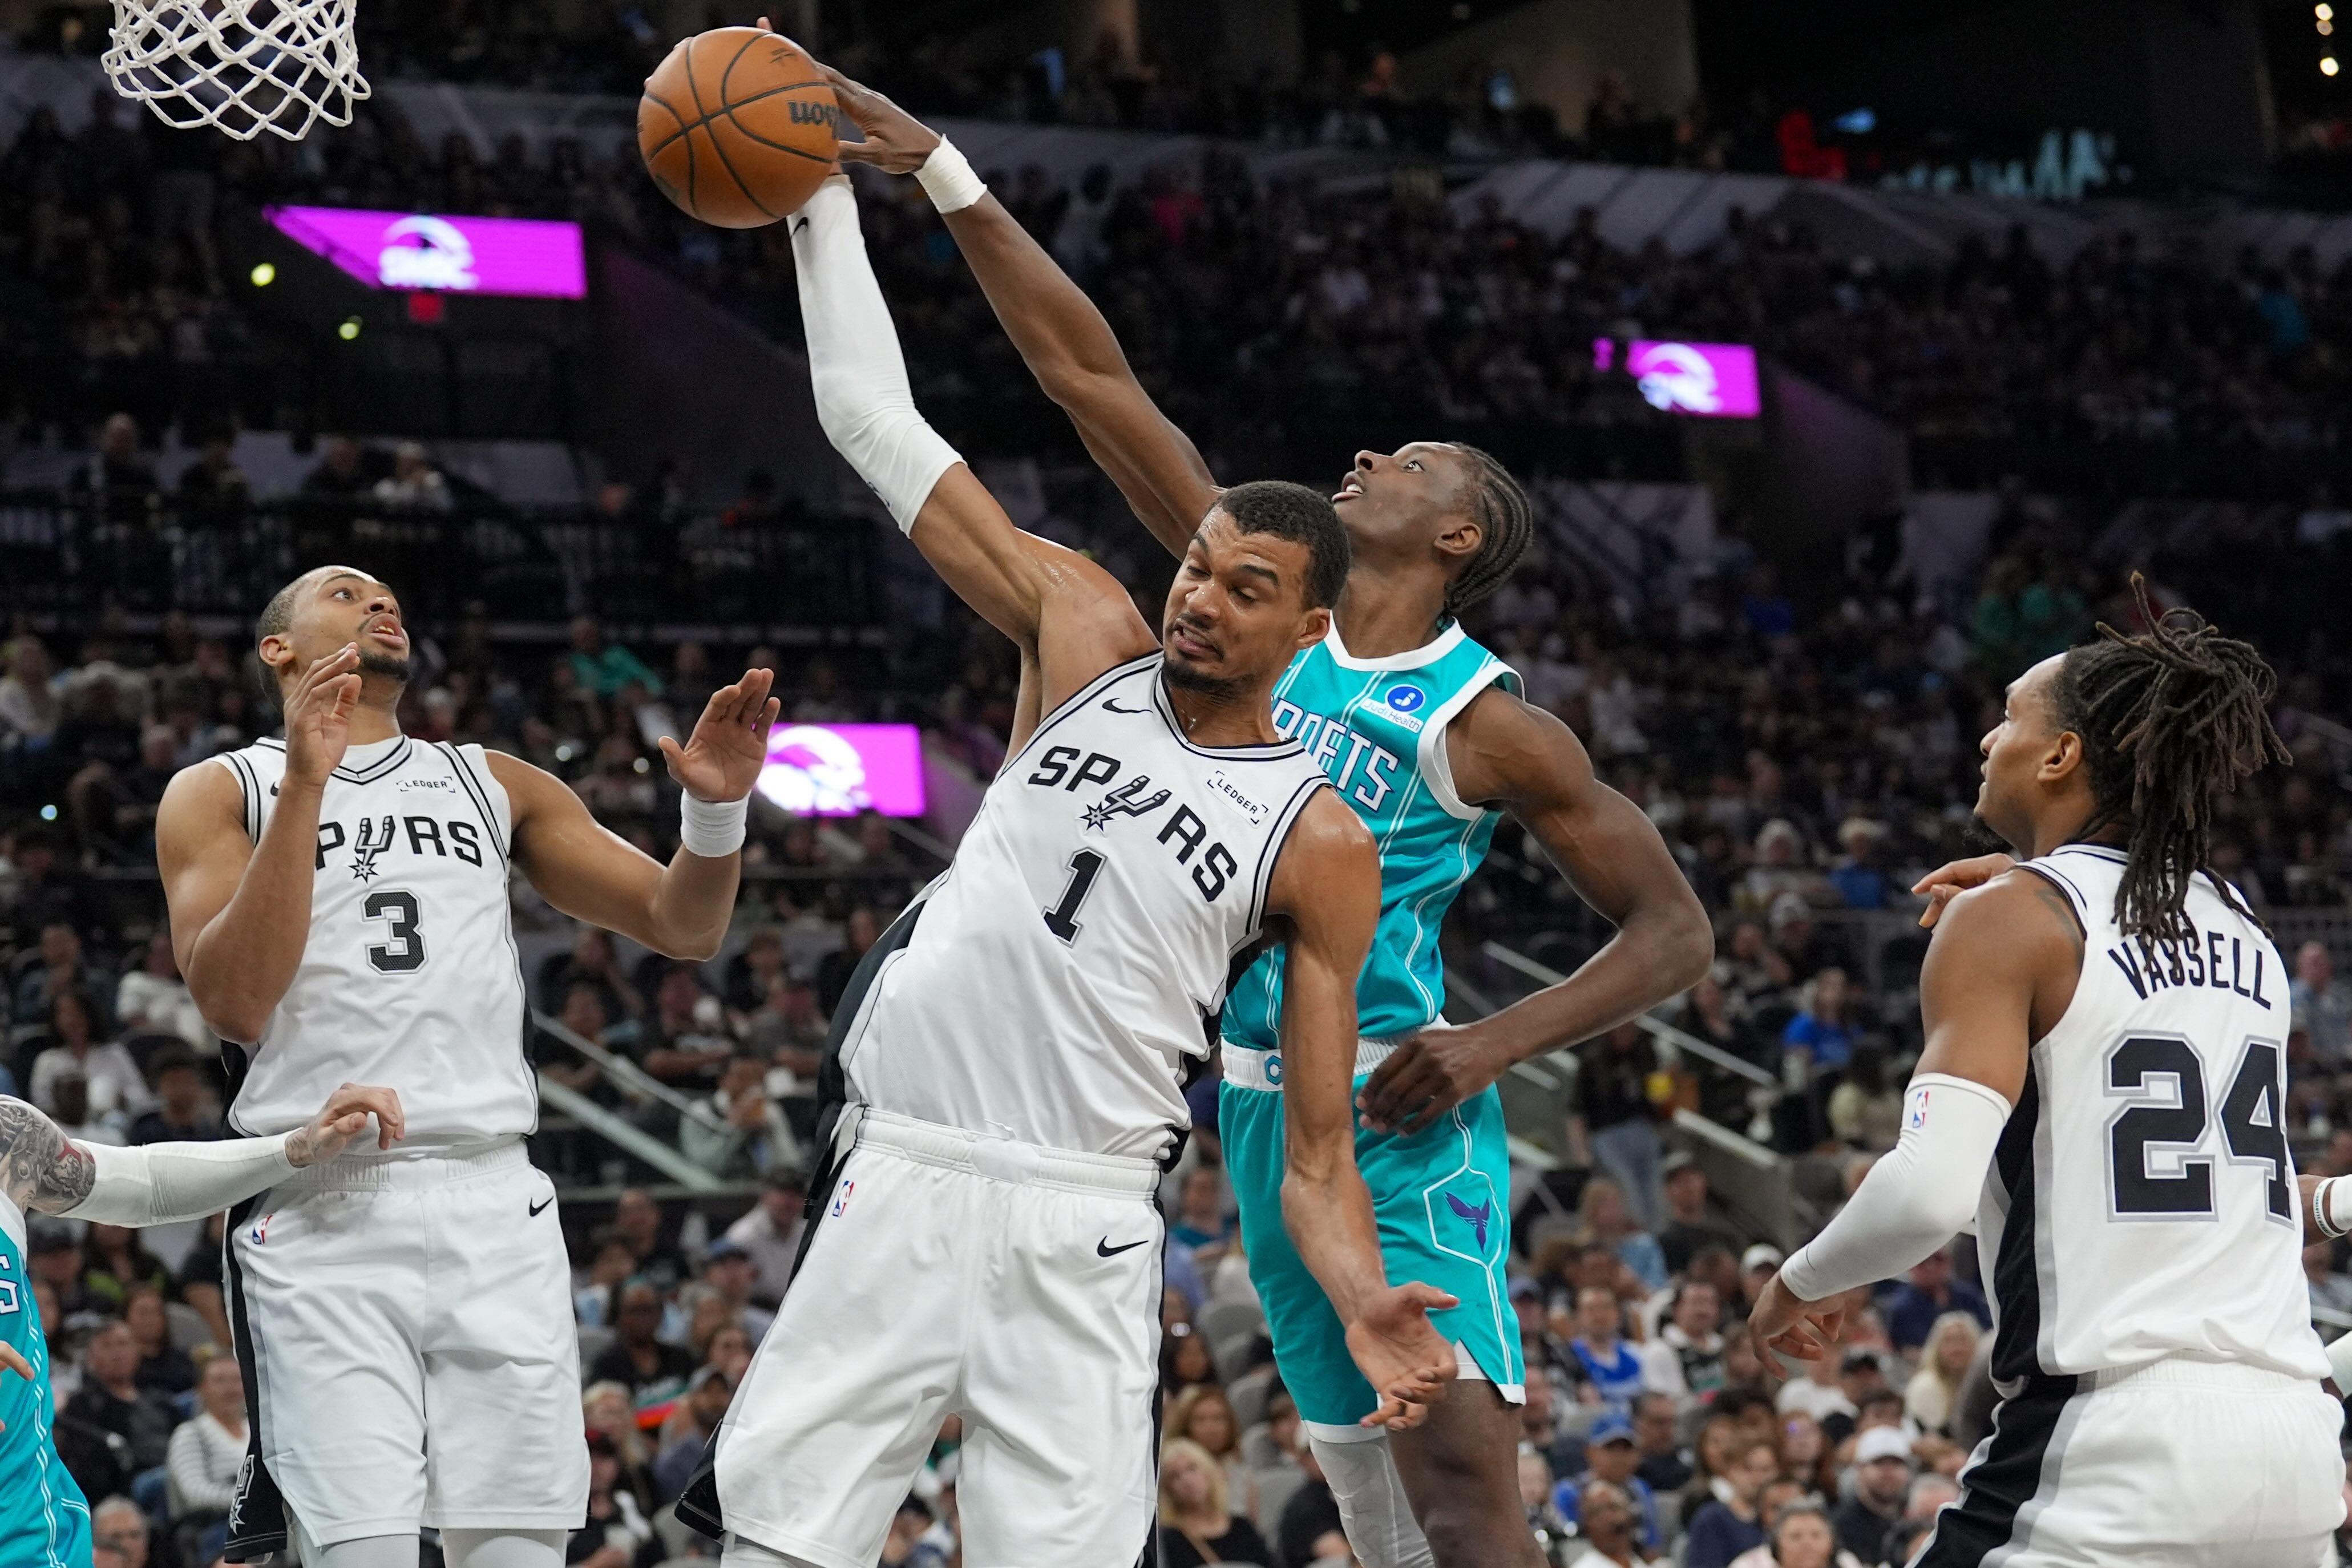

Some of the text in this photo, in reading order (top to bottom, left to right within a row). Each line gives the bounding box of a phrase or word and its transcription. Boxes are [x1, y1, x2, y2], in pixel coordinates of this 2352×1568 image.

[1387, 711, 1420, 732] Health
[405, 779, 447, 788] LEDGER
[1217, 778, 1258, 814] LEDGER
[316, 815, 482, 883] PURS
[1028, 746, 1238, 902] SPURS
[359, 888, 429, 976] 3
[1042, 846, 1108, 949] 1
[2102, 1029, 2295, 1230] 24
